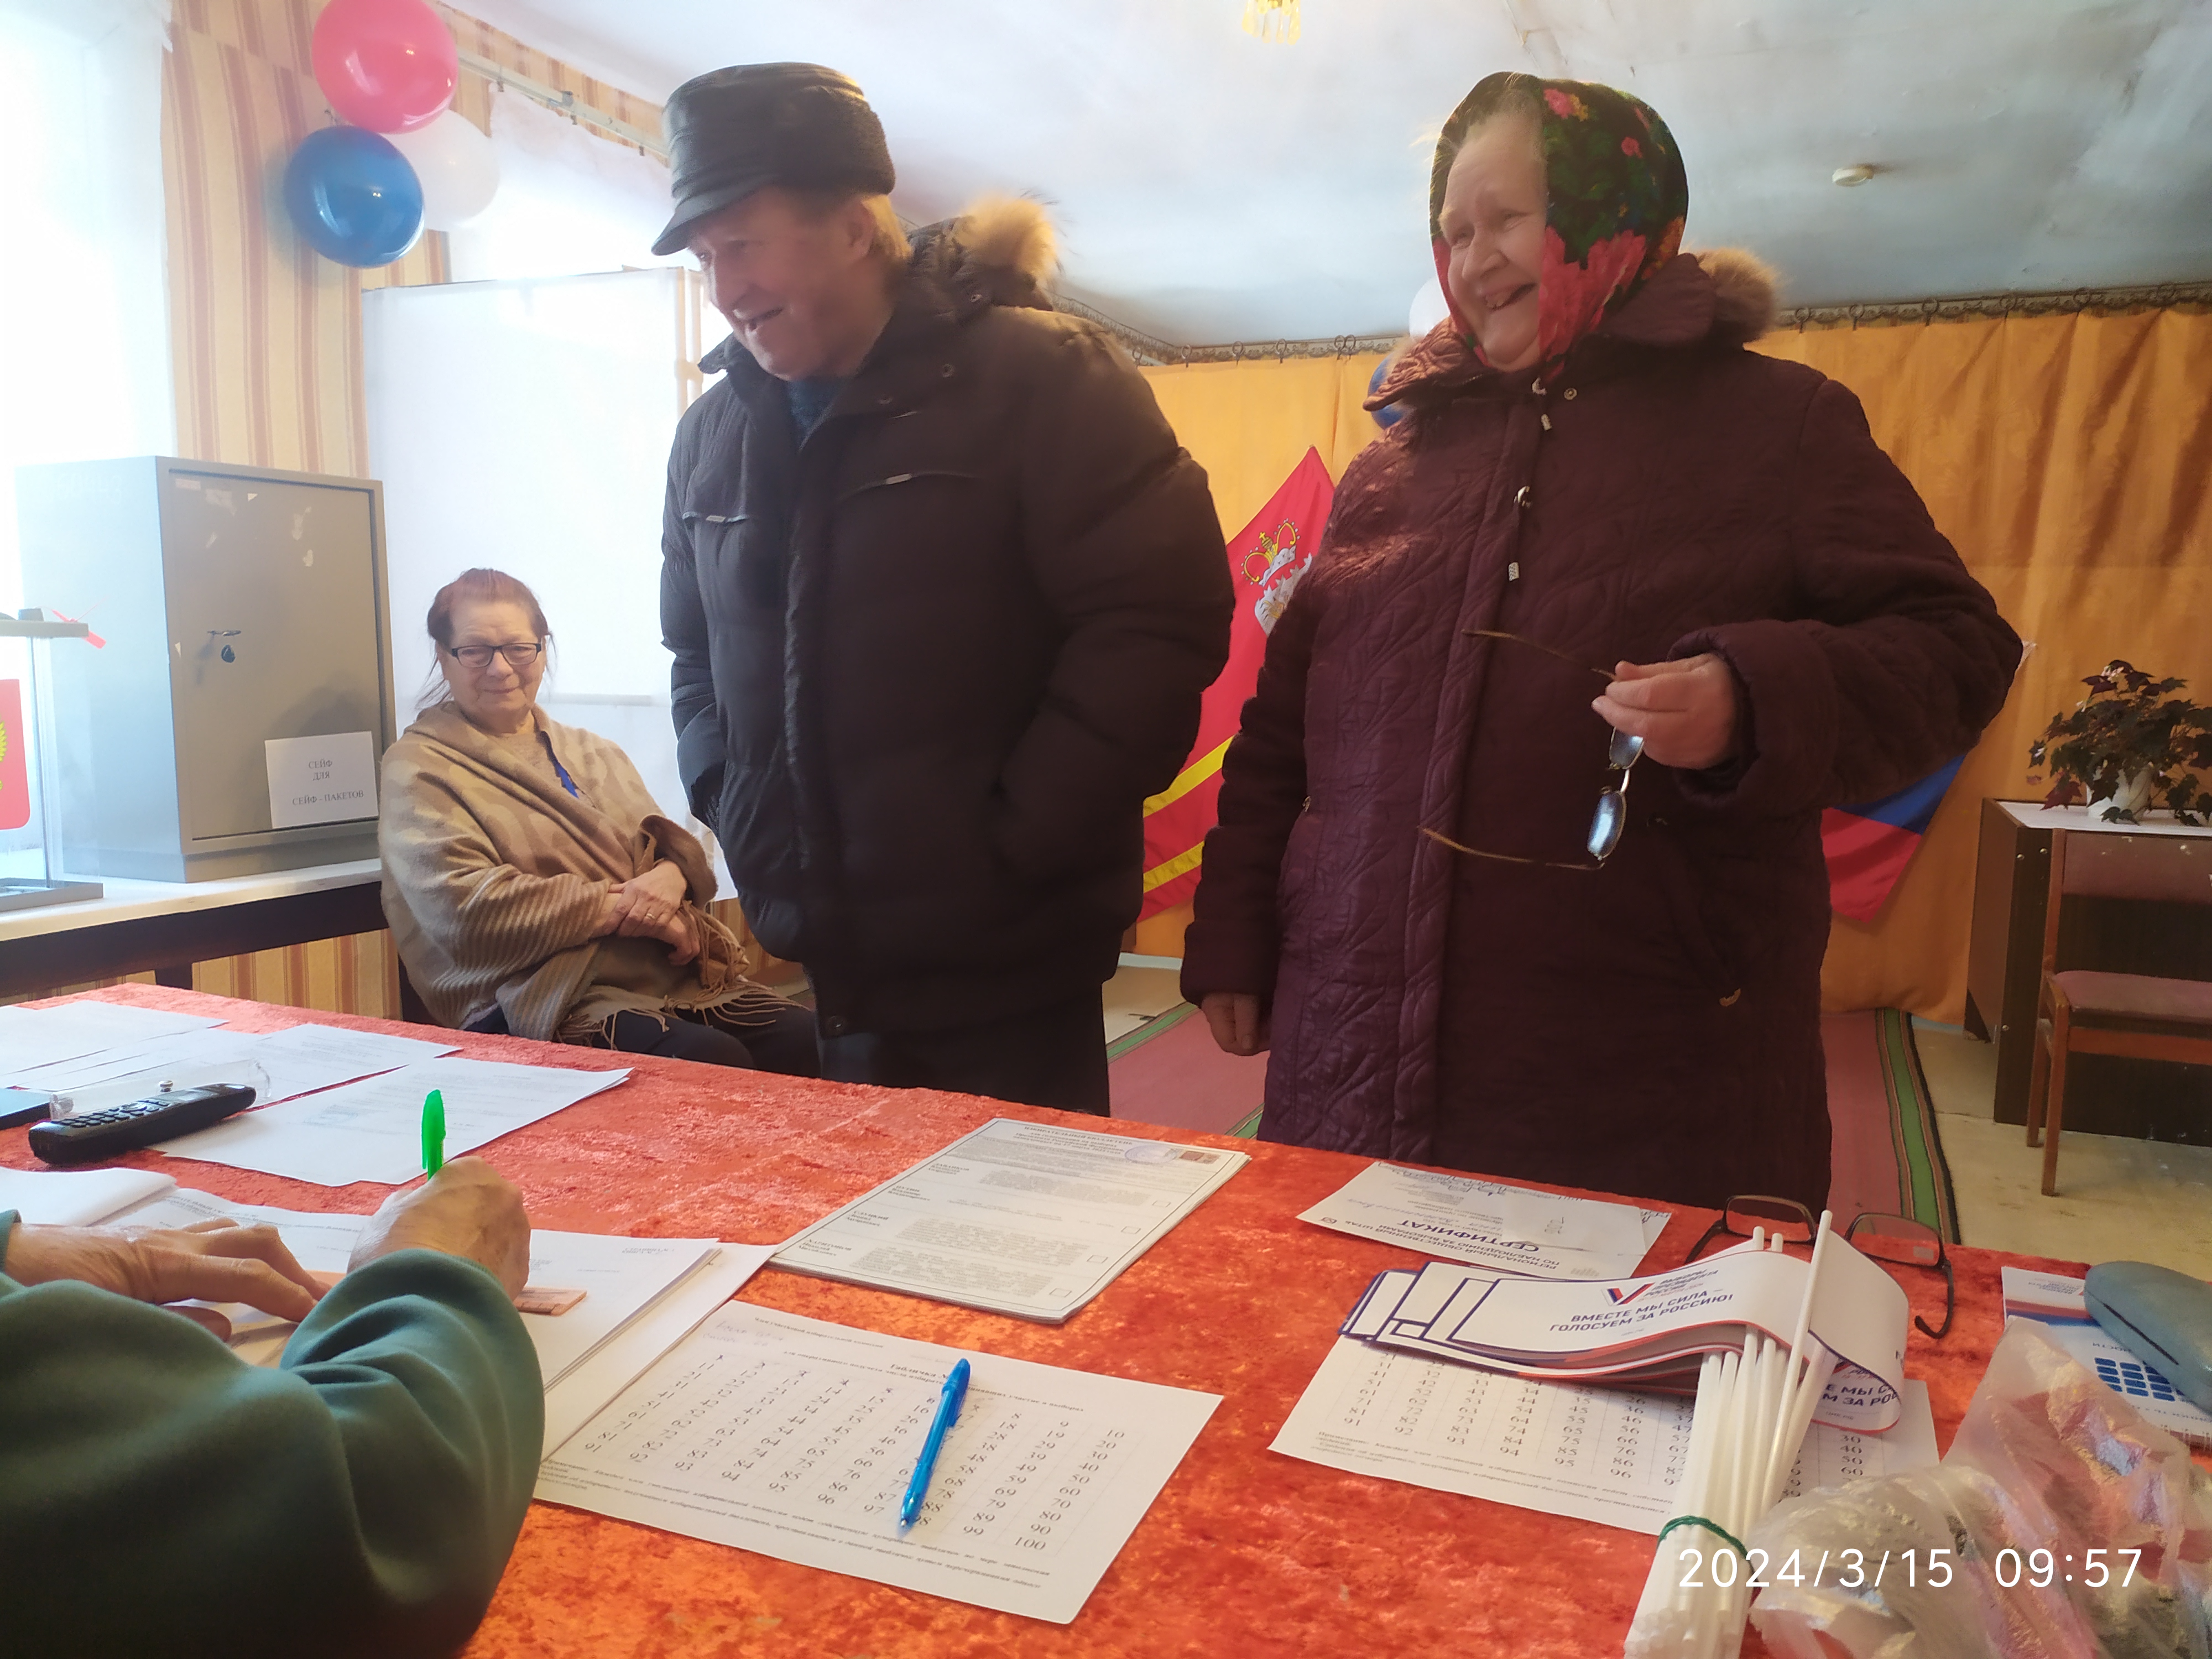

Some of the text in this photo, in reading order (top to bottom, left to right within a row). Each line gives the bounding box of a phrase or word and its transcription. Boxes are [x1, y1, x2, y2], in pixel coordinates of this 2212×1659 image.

[309, 759, 332, 769] СЕЙФ
[312, 771, 330, 781] ДЛЯ
[292, 794, 317, 805] СЕЙФ
[324, 790, 364, 801] ПАКЕТОВ
[1345, 1220, 1557, 1269] РЕГИОНАЛЬНЫЙ ОБЩЕСТВЕННЫЙ ШТАБ
[1379, 1225, 1439, 1241] ВЫБОРАМИ
[1397, 1220, 1539, 1252] СЕРТИФИКАТ
[1458, 1242, 1541, 1261] НАБЛЮДЕНИЮ
[1550, 1294, 1734, 1332] ГОЛОСУЕМ ЗА РОССИЮ!
[1571, 1310, 1632, 1322] ВМЕСТЕ
[1635, 1302, 1663, 1314] МЫ
[1667, 1290, 1708, 1306] СИЛА
[1841, 1386, 1874, 1396] МЫ
[1843, 1397, 1864, 1406] ЗА
[1349, 1407, 1633, 1467] 81 82 83 84 85 86
[1406, 1406, 1423, 1415] 72
[1458, 1415, 1473, 1424] 73
[1510, 1426, 1526, 1435] 74
[1562, 1436, 1580, 1445] 75
[1617, 1446, 1635, 1455] 76
[1414, 1388, 1432, 1396] 52
[1516, 1406, 1532, 1414] 54
[1567, 1415, 1585, 1424] 55
[1621, 1425, 1639, 1434] 56
[1841, 1467, 1867, 1478] 60
[1618, 1436, 1637, 1444] 66
[773, 1426, 1081, 1496] 54 55 56 58 59 60
[1395, 1427, 1413, 1435] 92
[1447, 1436, 1465, 1445] 93
[1500, 1447, 1519, 1456] 94
[1555, 1458, 1574, 1467] 95
[1611, 1469, 1631, 1478] 96
[1840, 1446, 1862, 1454] 40
[1842, 1455, 1863, 1464] 50
[749, 1448, 768, 1458] 74
[795, 1458, 815, 1468] 75
[843, 1469, 860, 1479] 76
[935, 1489, 954, 1499] 78
[987, 1499, 1006, 1509] 79
[1039, 1511, 1061, 1521] 80
[761, 1437, 781, 1446] 64
[807, 1447, 827, 1457] 65
[854, 1458, 872, 1467] 66
[945, 1478, 966, 1486] 68
[995, 1488, 1016, 1496] 69
[1052, 1498, 1071, 1509] 70
[722, 1472, 740, 1481] 94
[769, 1483, 789, 1492] 95
[818, 1494, 834, 1504] 96
[864, 1505, 885, 1515] 97
[963, 1526, 984, 1536] 99
[1015, 1537, 1046, 1550] 100
[733, 1459, 754, 1469] 84
[780, 1471, 802, 1480] 85
[828, 1481, 848, 1491] 86
[874, 1492, 897, 1501] 87
[921, 1501, 943, 1512] 88
[973, 1513, 995, 1522] 89
[1031, 1524, 1051, 1535] 90
